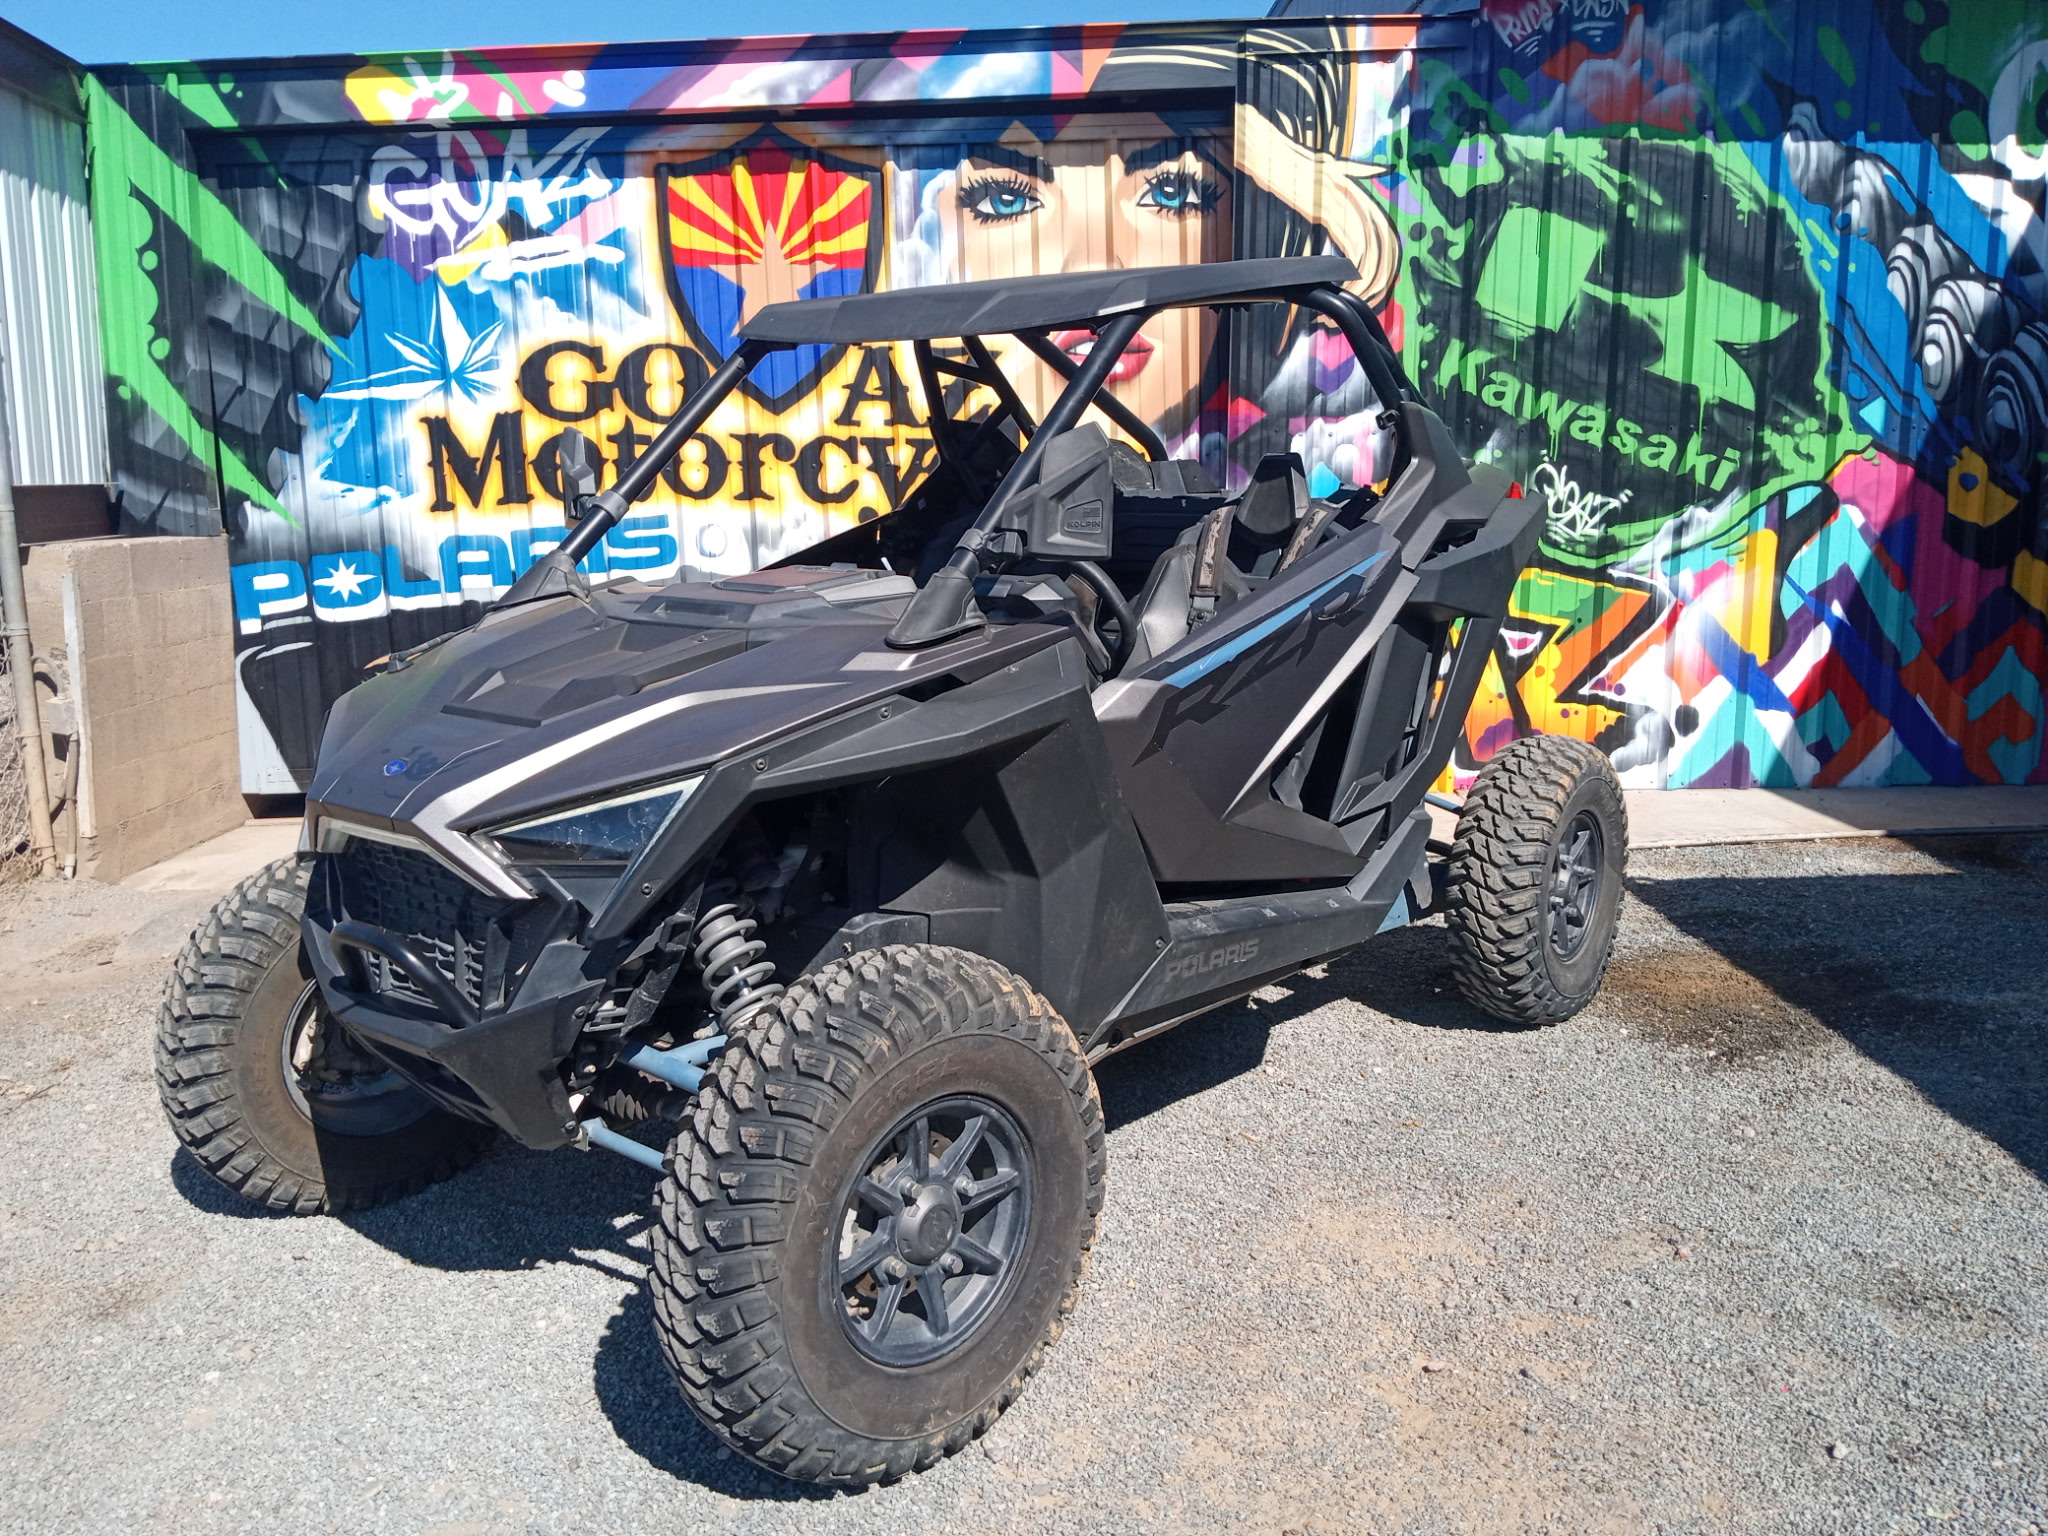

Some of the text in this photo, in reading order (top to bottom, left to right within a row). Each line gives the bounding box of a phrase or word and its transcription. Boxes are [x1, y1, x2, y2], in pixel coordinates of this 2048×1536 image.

[516, 340, 710, 424] GO
[1433, 338, 1742, 492] Kawasaki
[1067, 520, 1101, 528] KOLPIN
[1165, 938, 1260, 983] POLARIS
